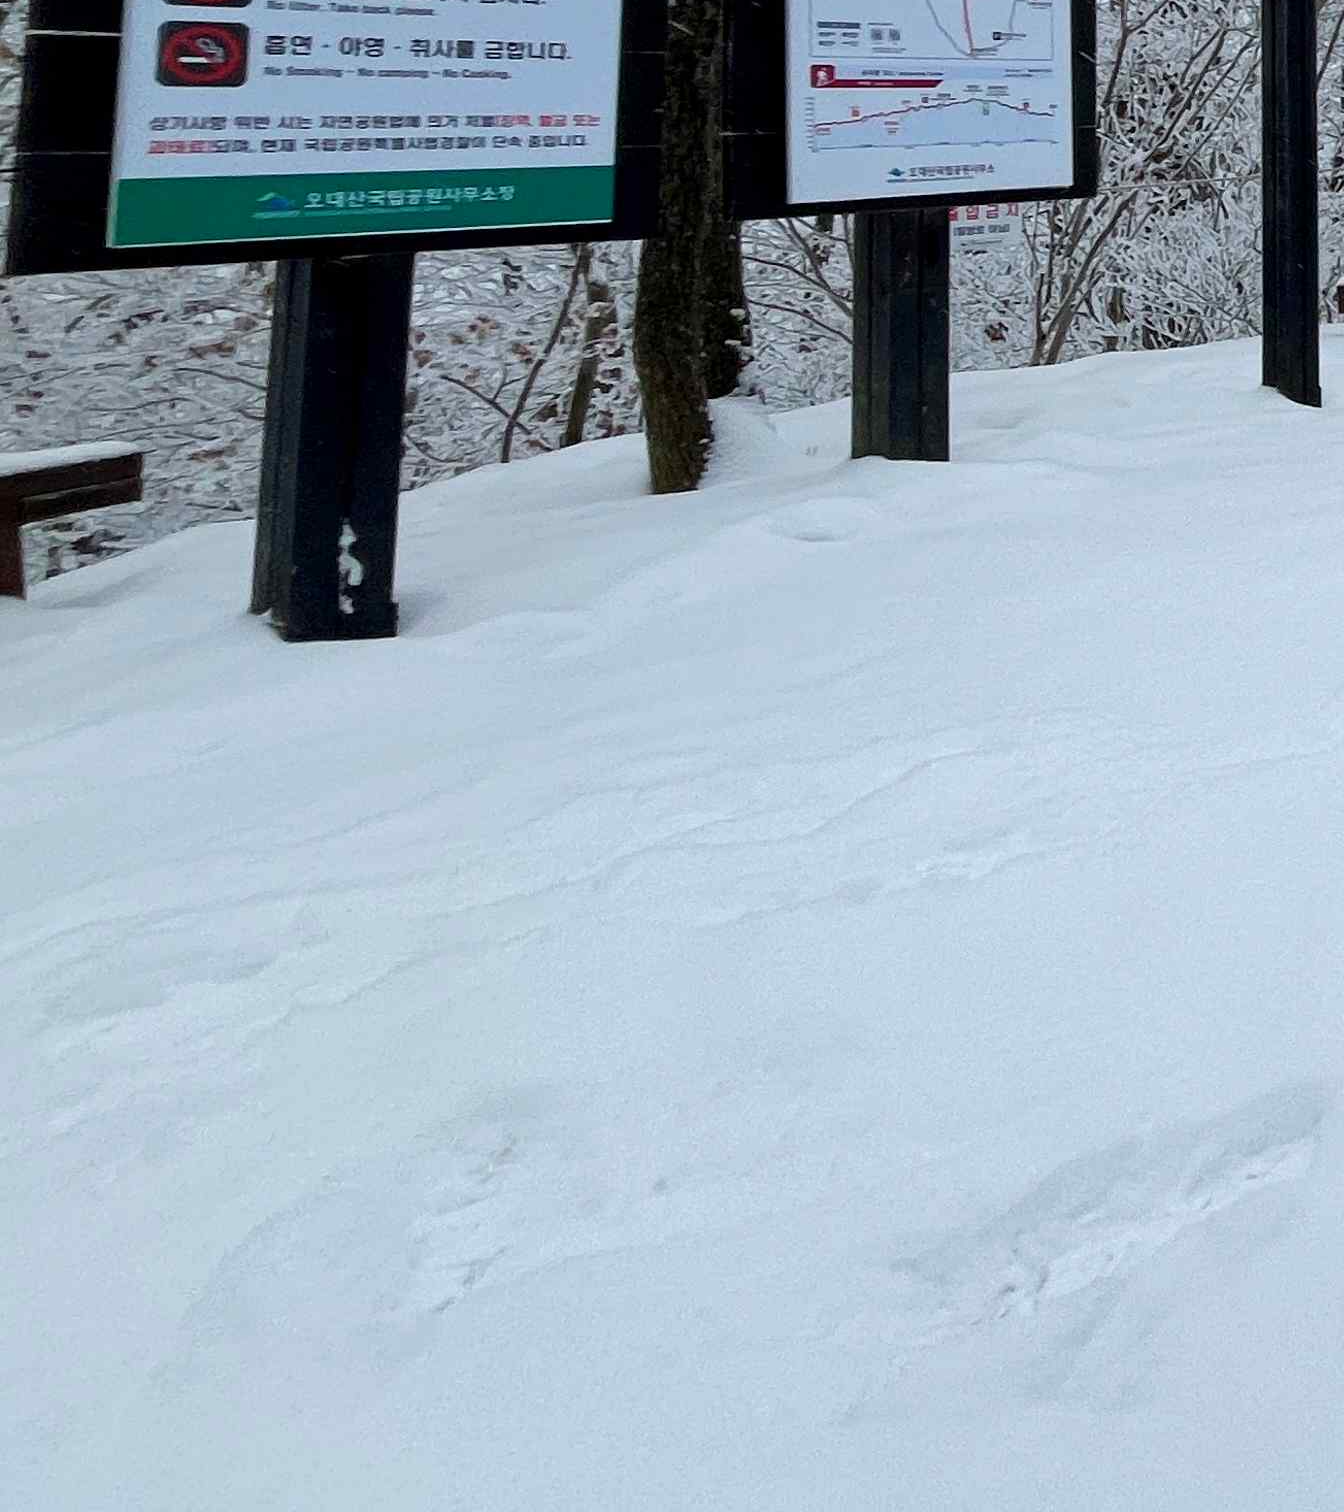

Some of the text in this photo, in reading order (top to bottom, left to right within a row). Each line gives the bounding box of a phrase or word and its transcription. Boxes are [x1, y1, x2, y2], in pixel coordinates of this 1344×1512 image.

[265, 35, 312, 56] 흡연
[410, 39, 474, 59] 취사를
[485, 40, 572, 60] 금합니다.
